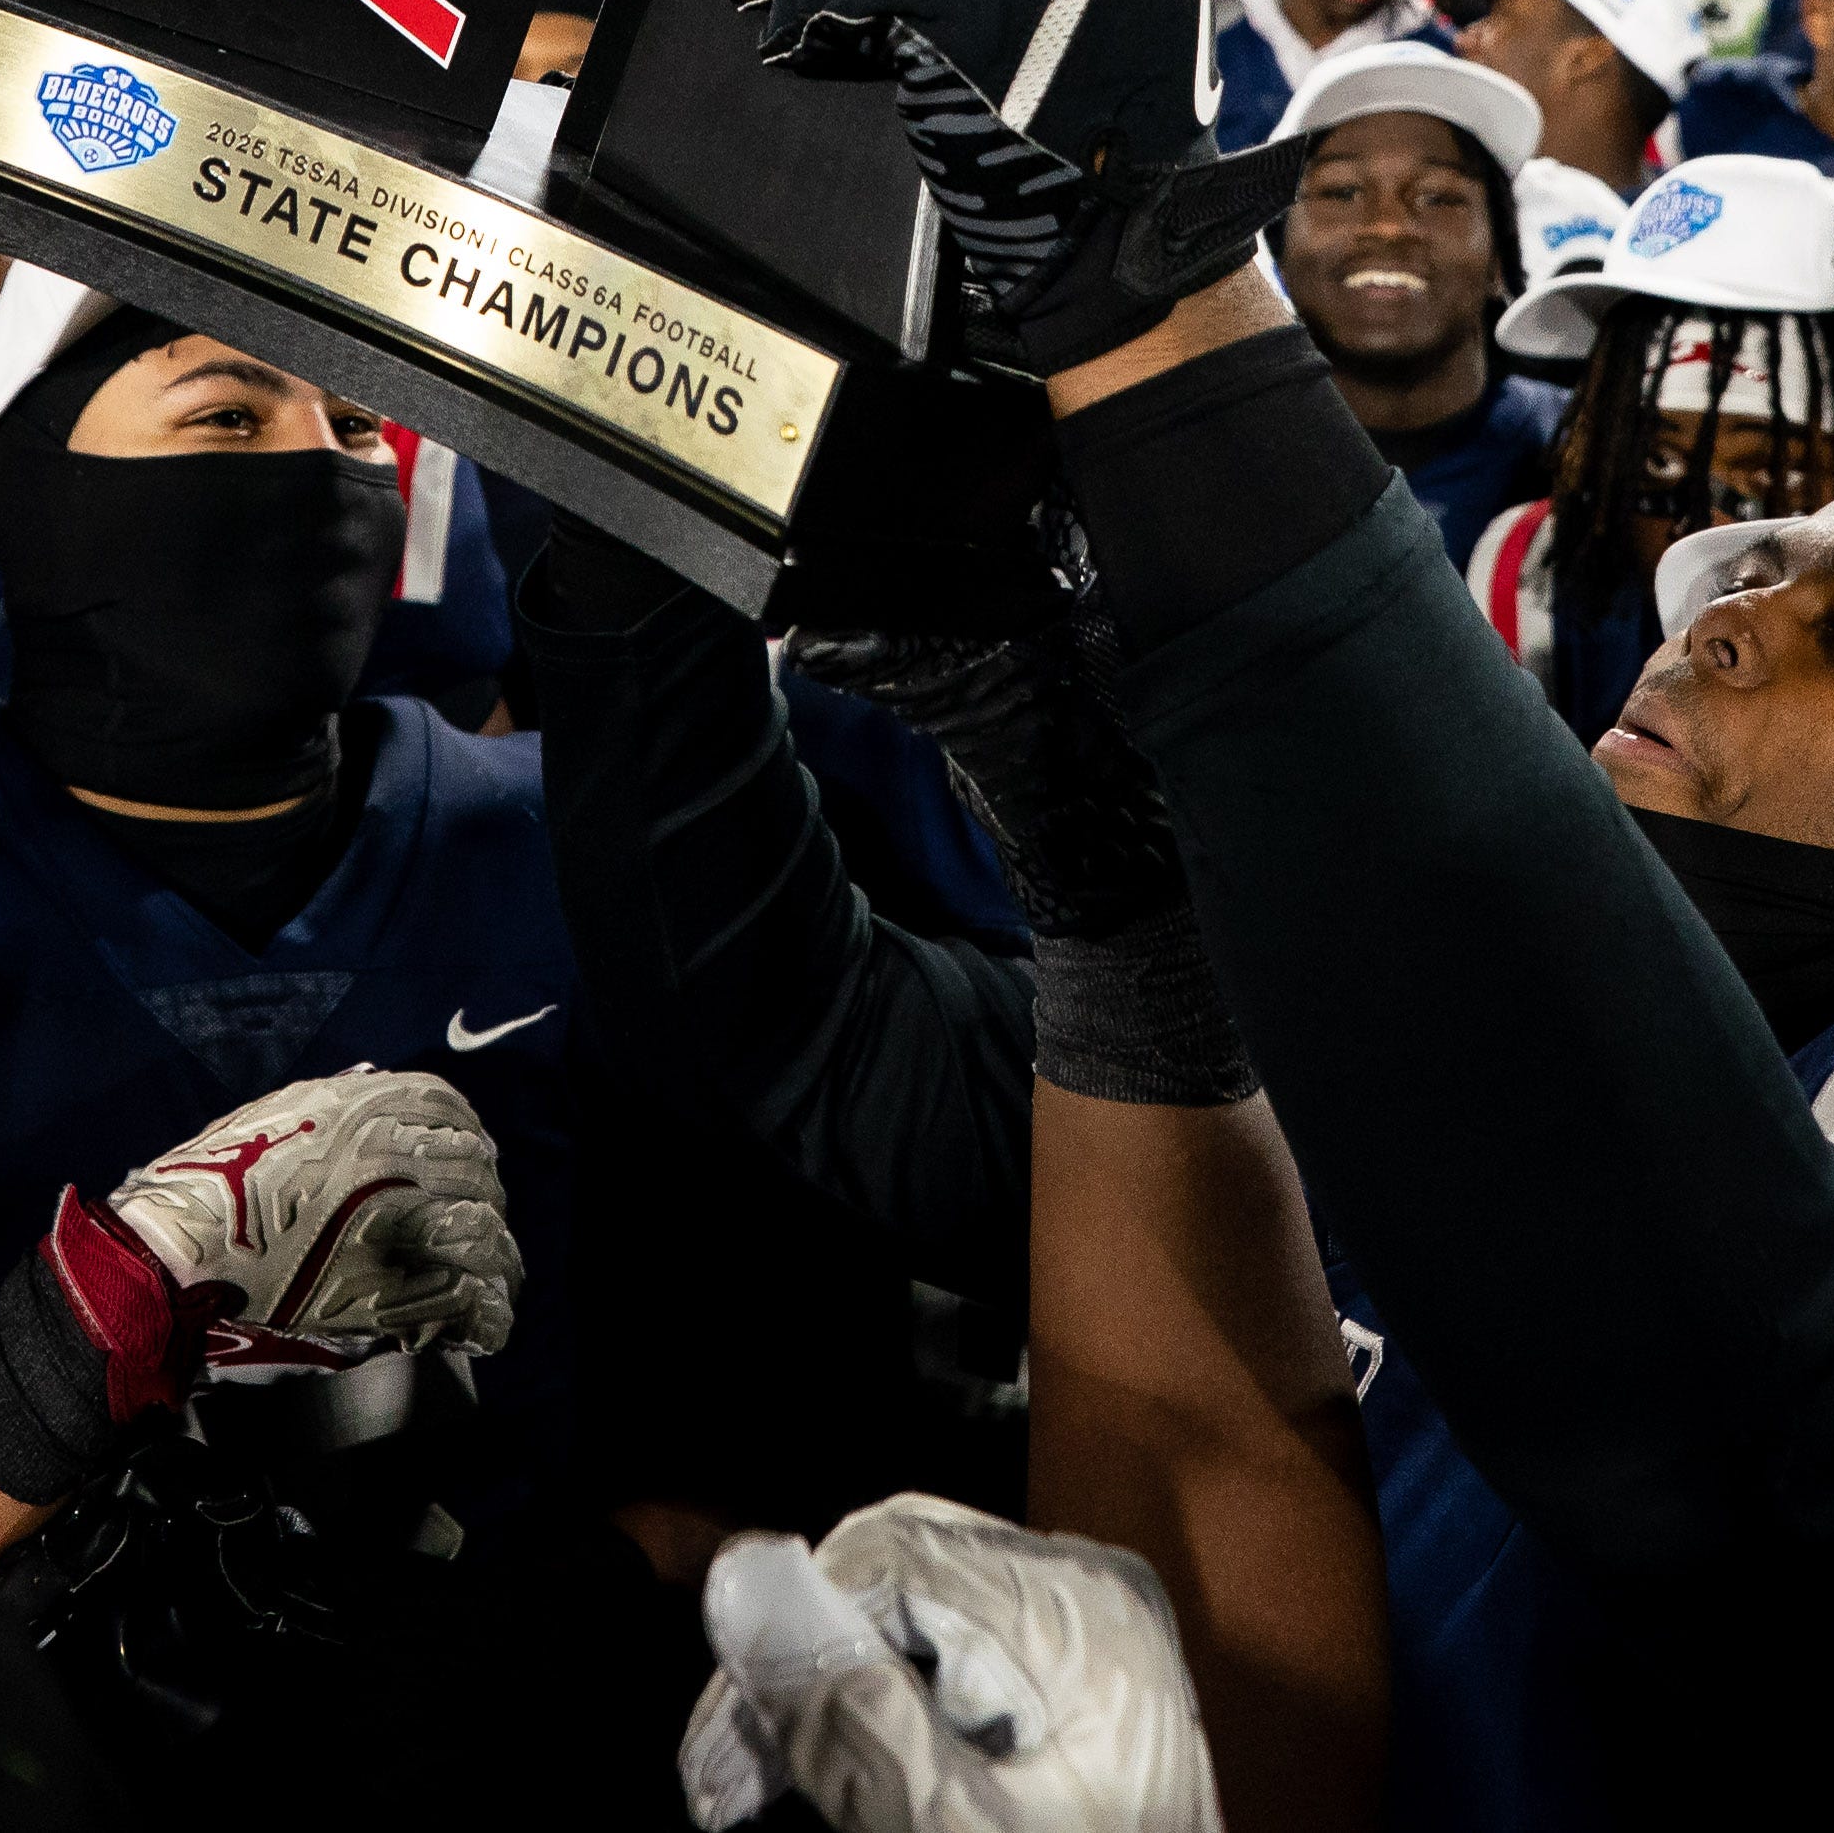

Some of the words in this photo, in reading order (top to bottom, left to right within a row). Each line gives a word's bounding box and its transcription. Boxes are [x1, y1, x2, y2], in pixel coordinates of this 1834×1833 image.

[41, 75, 172, 144] BLUECROSS
[71, 104, 135, 140] BOWL
[192, 156, 379, 265] STATE
[400, 242, 744, 436] CHAMPIONS
[278, 147, 360, 200] TSSAA
[371, 186, 486, 250] DIVISION
[508, 246, 589, 299] CLASS
[593, 285, 623, 316] 6A
[632, 303, 759, 383] FOOTBALL
